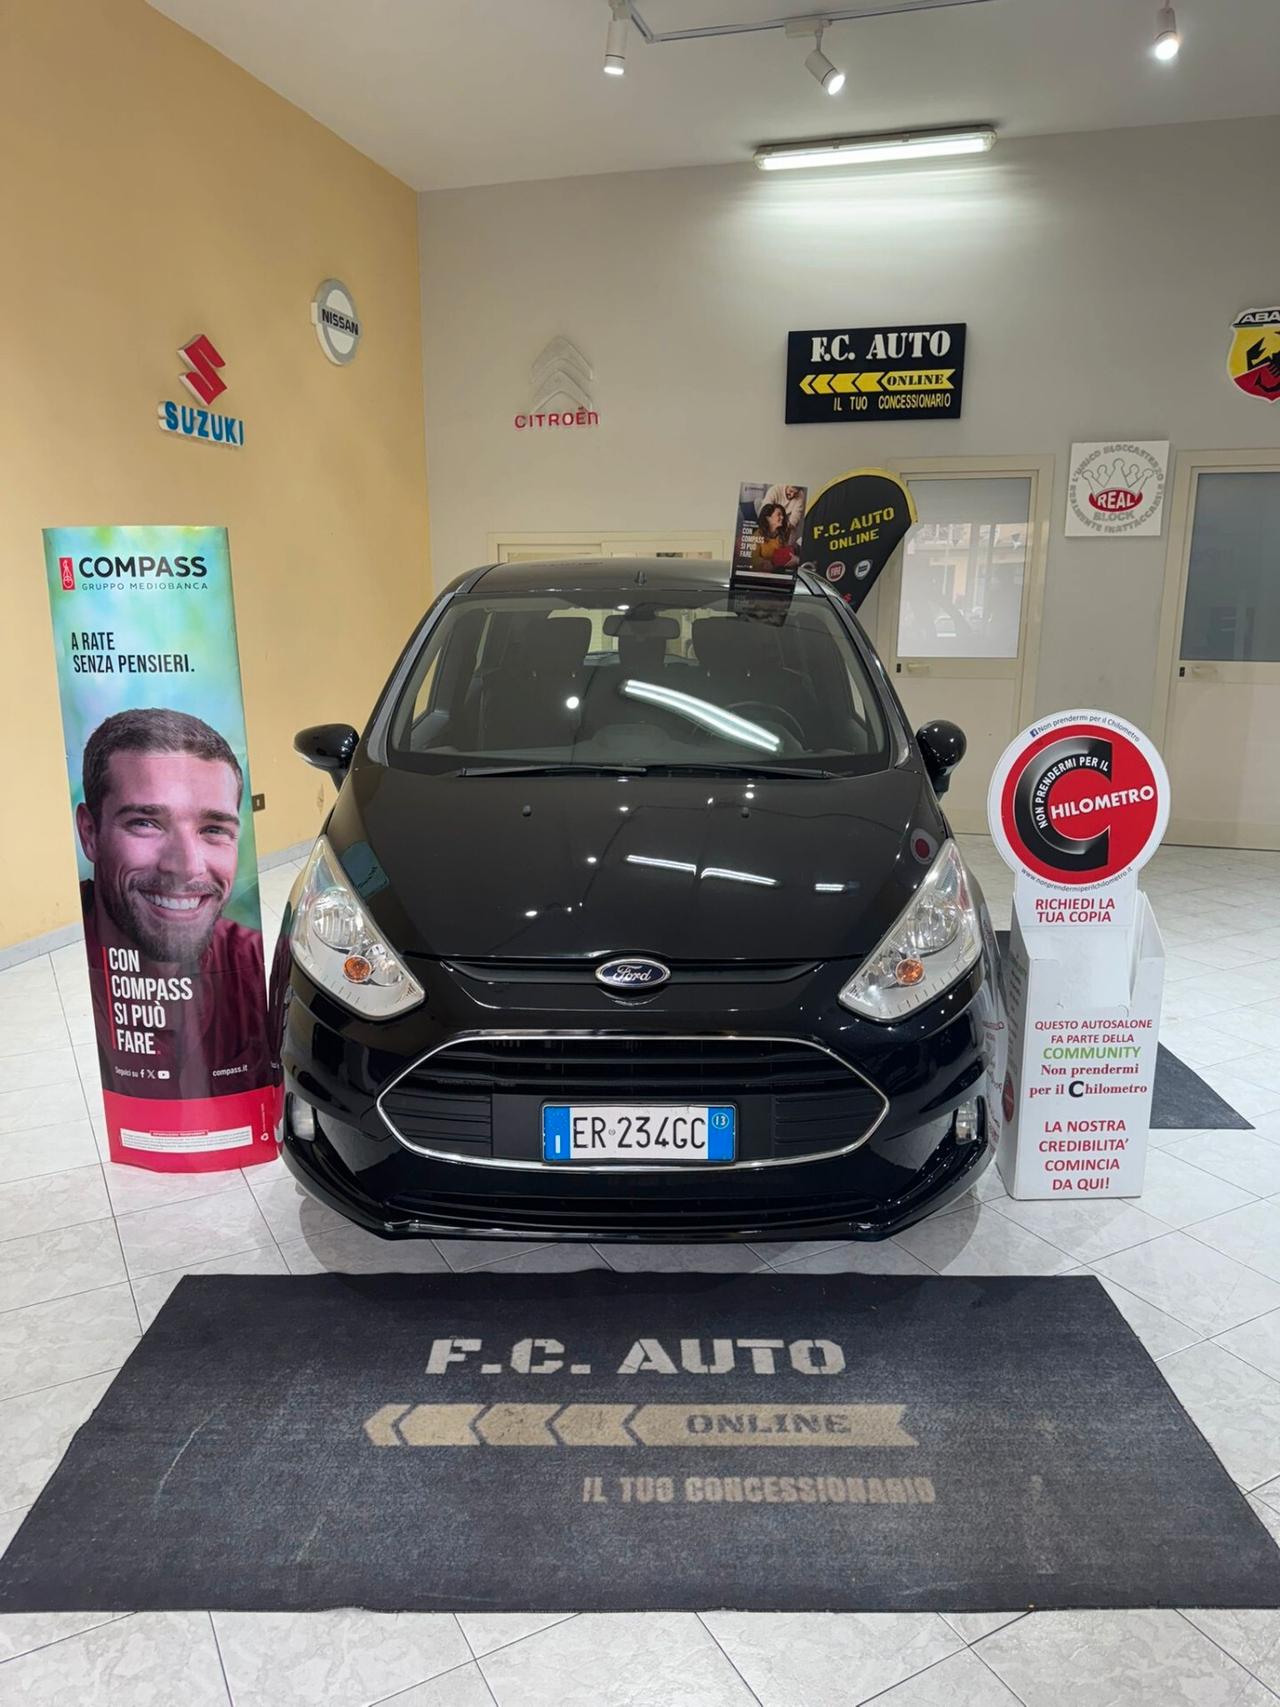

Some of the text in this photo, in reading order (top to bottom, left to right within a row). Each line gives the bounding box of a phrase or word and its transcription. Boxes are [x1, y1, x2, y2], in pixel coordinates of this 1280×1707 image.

[322, 308, 359, 336] NISSAN
[810, 330, 951, 362] F.C. AUTO
[886, 373, 944, 387] ONLINE
[833, 393, 951, 411] IL TUO CONCESSIONARIO
[164, 400, 244, 446] SUZUKI
[1097, 492, 1136, 509] REAL
[812, 506, 895, 540] F.C. AUTO
[828, 528, 880, 552] ONLINE
[78, 556, 208, 578] COMPASS
[81, 582, 208, 591] GRUPPO MEDIOBANCA
[71, 632, 116, 651] A RATE
[73, 654, 195, 673] SENZA PENSIERI.
[1038, 722, 1052, 733] Non
[1053, 715, 1088, 727] prendermi
[1089, 715, 1102, 723] per
[1107, 718, 1140, 742] Chilometro
[1035, 756, 1109, 829] NON PRENDERMI PER IL
[1035, 898, 1116, 910] RICHIEDI LA
[1037, 911, 1112, 923] TUA COPIA
[108, 946, 141, 973] CON
[612, 964, 652, 982] Ford
[111, 975, 193, 1001] COMPASS
[114, 1000, 166, 1028] SI PUÒ
[1035, 1019, 1152, 1031] QUESTO AUTOSALONE
[1051, 1034, 1134, 1044] FA PARTE DELLA
[1043, 1046, 1141, 1060] COMMUNITY
[212, 1065, 248, 1077] compass.it
[1041, 1063, 1139, 1078] Non prendermi
[1029, 1080, 1148, 1098] per il Chilometro
[713, 1116, 727, 1127] 13
[1045, 1120, 1126, 1132] LA NOSTRA
[1045, 1158, 1120, 1171] COMINCIA
[1052, 1177, 1110, 1191] DA QUI!
[425, 1338, 846, 1375] F.C. AUTO
[686, 1413, 852, 1434] ONLINE
[581, 1476, 936, 1504] IL TUO CONCESSIONARIO
